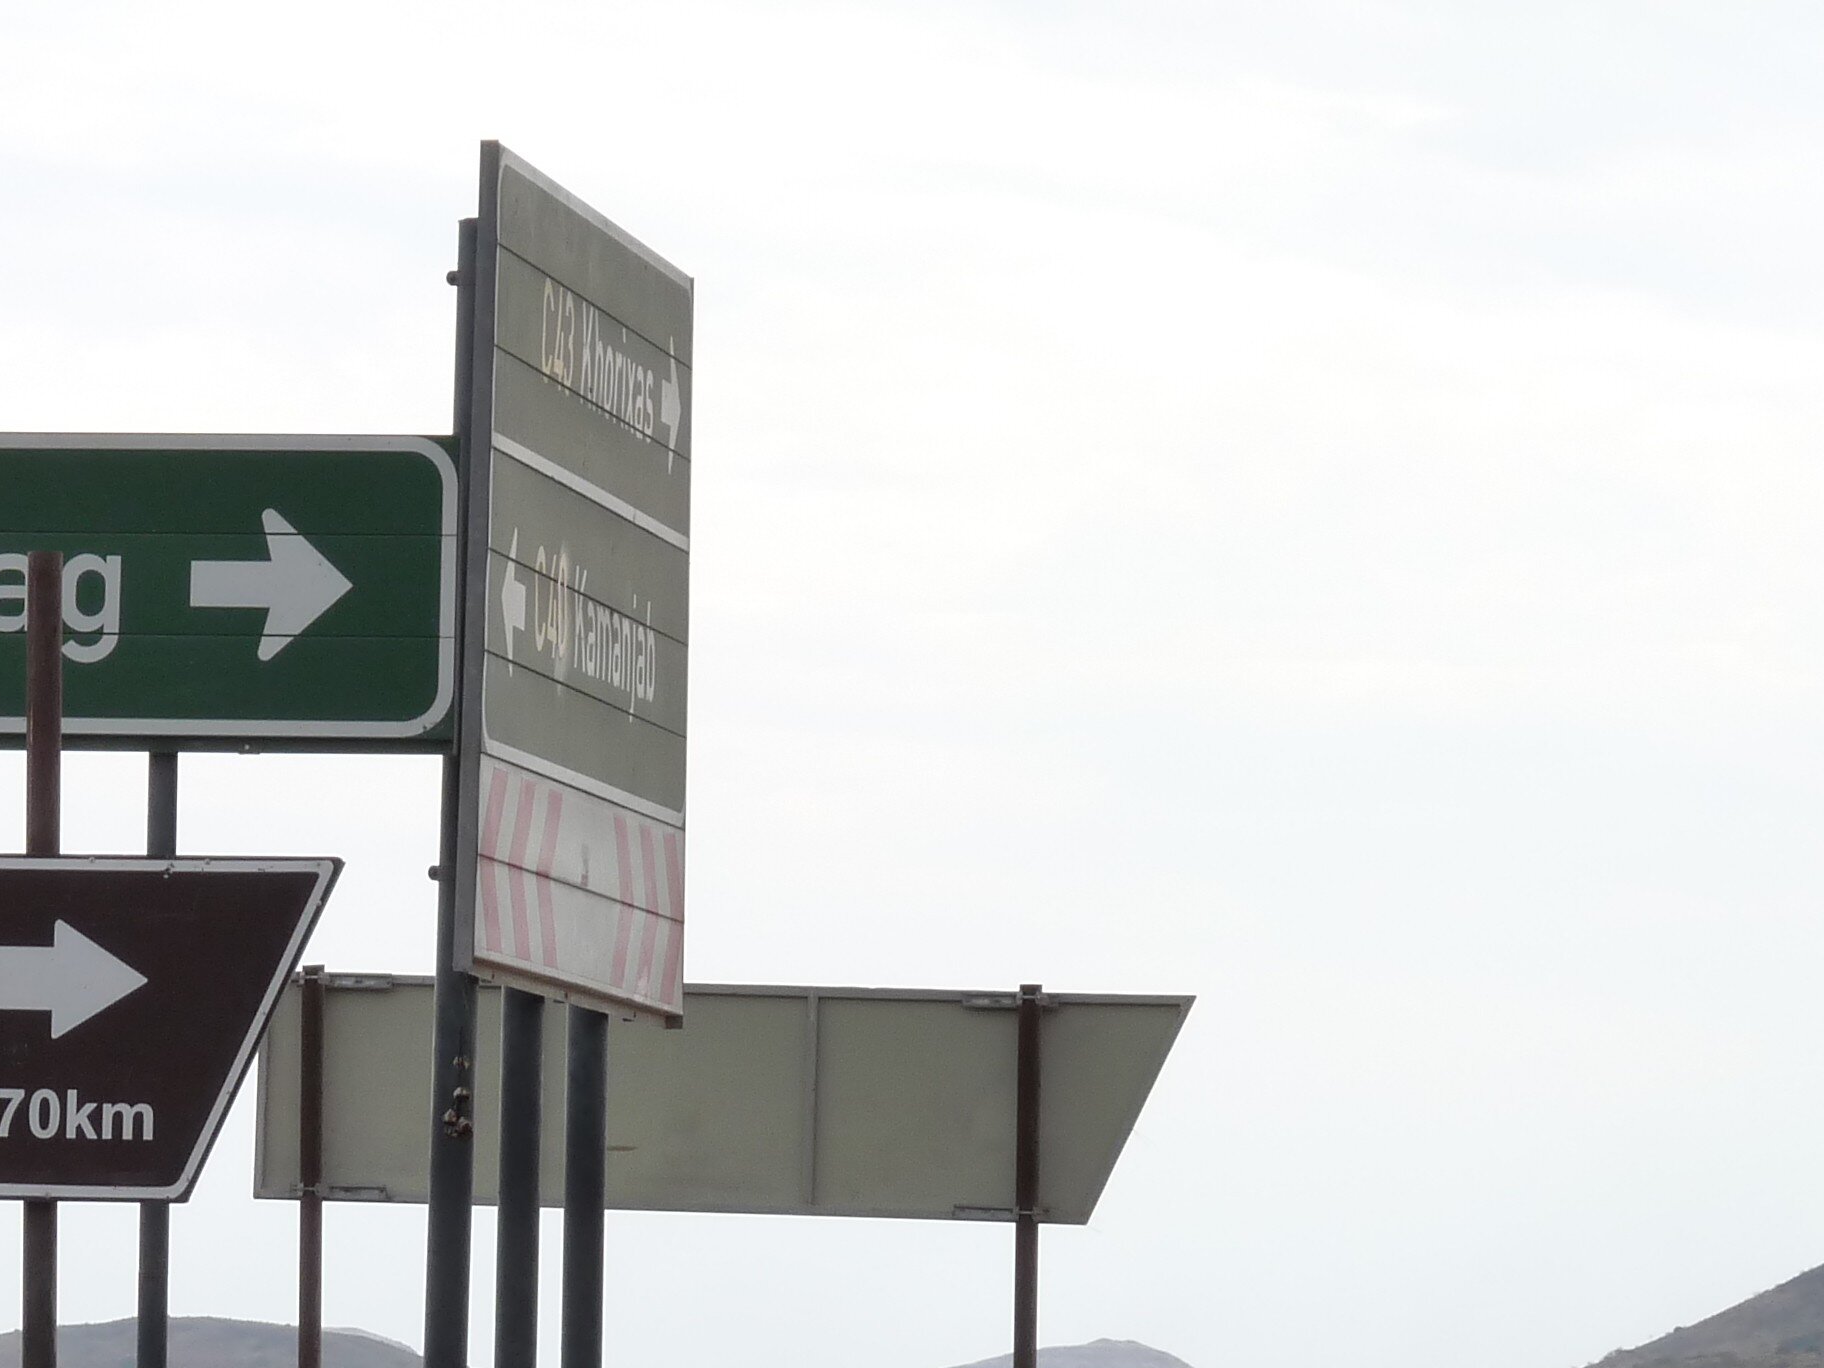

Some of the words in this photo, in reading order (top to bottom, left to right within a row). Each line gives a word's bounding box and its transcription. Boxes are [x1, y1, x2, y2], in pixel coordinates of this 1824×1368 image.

[541, 277, 575, 396] C43
[580, 300, 655, 444] Khorixas
[573, 565, 656, 723] Kamanjab
